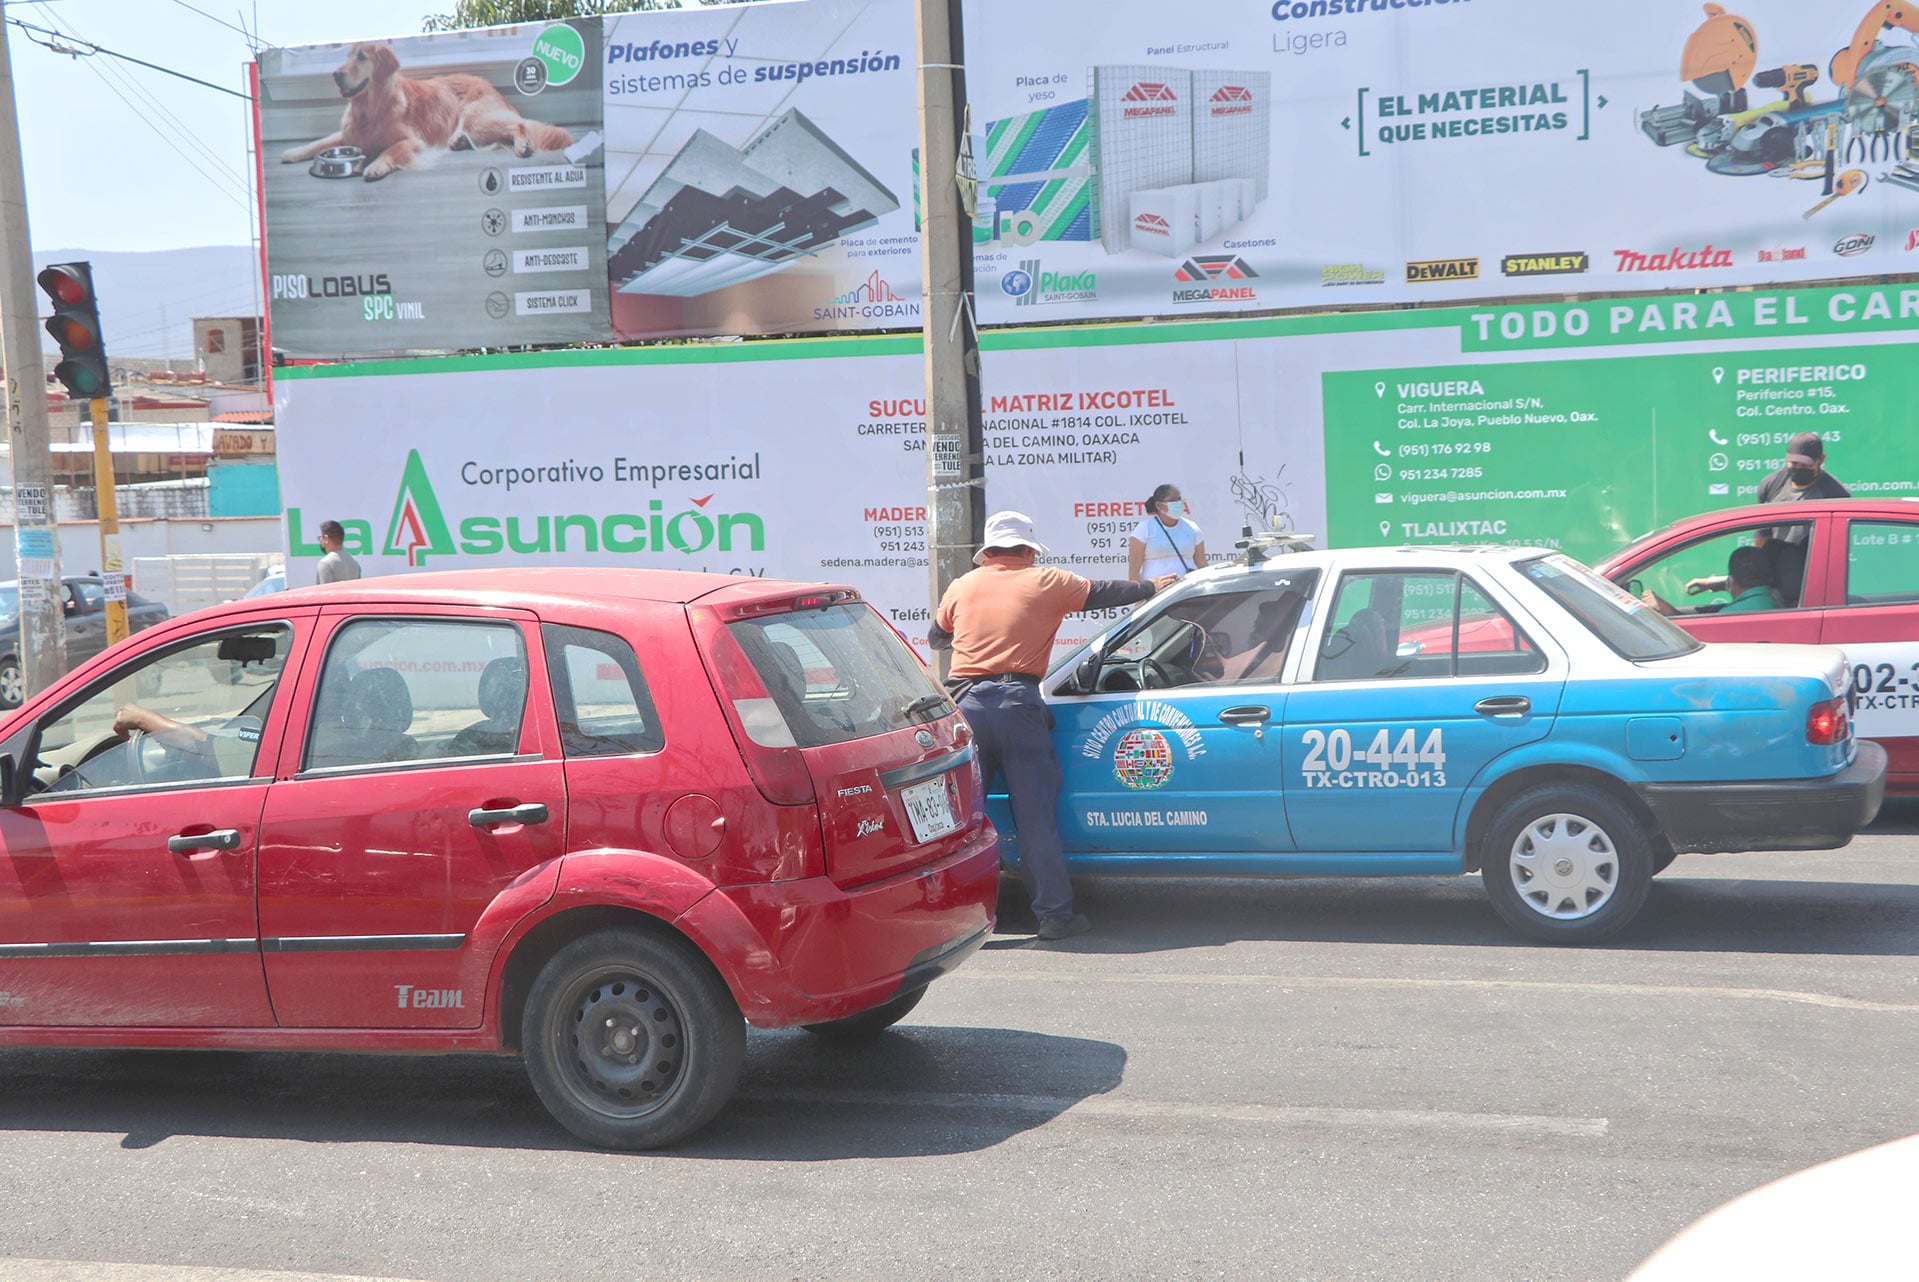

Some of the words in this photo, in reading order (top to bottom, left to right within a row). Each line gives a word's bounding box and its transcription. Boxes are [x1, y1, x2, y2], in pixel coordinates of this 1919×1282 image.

[1147, 45, 1175, 56] Panel
[1176, 40, 1230, 54] Estructural
[1272, 29, 1348, 55] Ligera
[536, 39, 579, 69] NUEVO
[607, 37, 719, 64] Plafones
[725, 38, 739, 58] y
[609, 69, 711, 95] sistemas
[717, 65, 748, 85] de
[754, 50, 901, 83] suspensión
[1015, 75, 1049, 88] Placa
[1052, 72, 1068, 84] de
[1028, 89, 1056, 104] yeso
[1378, 96, 1412, 117] EL
[1418, 83, 1568, 114] MATERIAL
[1123, 105, 1176, 118] MEGAPANEL
[1378, 122, 1426, 144] QUE
[1431, 112, 1568, 139] NECESITAS
[511, 172, 553, 186] RESISTENTE
[554, 171, 564, 183] AL
[565, 170, 585, 183] AGUA
[840, 239, 864, 247] Placa
[866, 237, 877, 246] de
[879, 236, 918, 245] cemento
[1223, 238, 1277, 249] Casetones
[847, 250, 866, 259] para
[868, 247, 912, 257] exteriores
[1758, 246, 1806, 262] Oaland
[1322, 263, 1363, 274] HIGH
[1505, 255, 1585, 273] STANLEY
[1321, 270, 1385, 282] POWER
[526, 296, 557, 309] SISTEMA
[557, 295, 578, 307] CLICK
[1044, 292, 1097, 302] SAINT-GOBAIN
[1172, 287, 1256, 303] MEGAPANEL
[364, 295, 393, 321] SPC
[396, 302, 425, 319] VINIL
[814, 303, 920, 320] SAINT-GOBAIN
[1471, 308, 1589, 341] TODO
[1609, 299, 1735, 334] PARA
[1754, 296, 1808, 326] EL
[1737, 364, 1866, 385] PERIFERICO
[1397, 380, 1484, 398] VIGUERA
[1736, 388, 1804, 401] Periferico
[991, 393, 1073, 413] MATRIZ
[1079, 389, 1175, 411] IXCOTEL
[1398, 403, 1427, 414] Carr.
[1429, 399, 1513, 413] Internacional
[1736, 405, 1762, 417] Col.
[1819, 402, 1850, 414] Oax.
[857, 421, 927, 436] CARRETER
[1051, 416, 1091, 429] #1814
[1095, 415, 1126, 428] COL.
[1130, 412, 1188, 426] IXCOTEL
[1398, 418, 1421, 429] Col.
[1424, 417, 1438, 428] La
[1477, 414, 1522, 426] Pueblo
[1524, 412, 1568, 425] Nuevo,
[1570, 411, 1599, 423] Oax.
[993, 436, 1019, 448] DEL
[1022, 434, 1079, 448] CAMINO,
[1082, 433, 1140, 446] OAXACA
[1736, 433, 1771, 447] (951)
[1398, 443, 1430, 457] (951)
[1431, 443, 1452, 455] 176
[1455, 442, 1471, 454] 92
[1474, 442, 1491, 453] 98
[998, 453, 1014, 466] LA
[1017, 453, 1055, 465] ZONA
[1058, 450, 1117, 465] MILITAR)
[1736, 459, 1761, 471] 951
[461, 459, 604, 491] Corporativo
[614, 453, 760, 488] Empresarial
[1399, 469, 1422, 480] 951
[1424, 468, 1449, 479] 234
[1451, 466, 1483, 478] 7285
[1401, 489, 1567, 505] viguera@asuncion.com.mx
[287, 507, 373, 557] La
[874, 525, 902, 538] (951)
[904, 526, 924, 537] 513
[1087, 521, 1116, 535] (951)
[1402, 520, 1507, 538] TLALIXTAC
[880, 541, 901, 551] 951
[903, 541, 925, 551] 243
[1090, 538, 1111, 548] 951
[1853, 533, 1886, 545] Lote
[1888, 534, 1899, 544] B
[1900, 534, 1911, 543] #
[820, 556, 929, 568] sedena.madera@as
[1404, 584, 1433, 596] (951)
[1091, 714, 1118, 744] CENTRO
[1112, 701, 1145, 728] CULTURAL
[1302, 728, 1447, 771] 20-444
[1302, 770, 1447, 788] TX-CTRO-013
[837, 783, 873, 798] FIESTA
[1087, 811, 1110, 826] STA.
[1111, 811, 1142, 826] LUCIA
[1144, 811, 1165, 825] DEL
[1166, 810, 1207, 826] CAMINO
[394, 984, 466, 1009] Team
